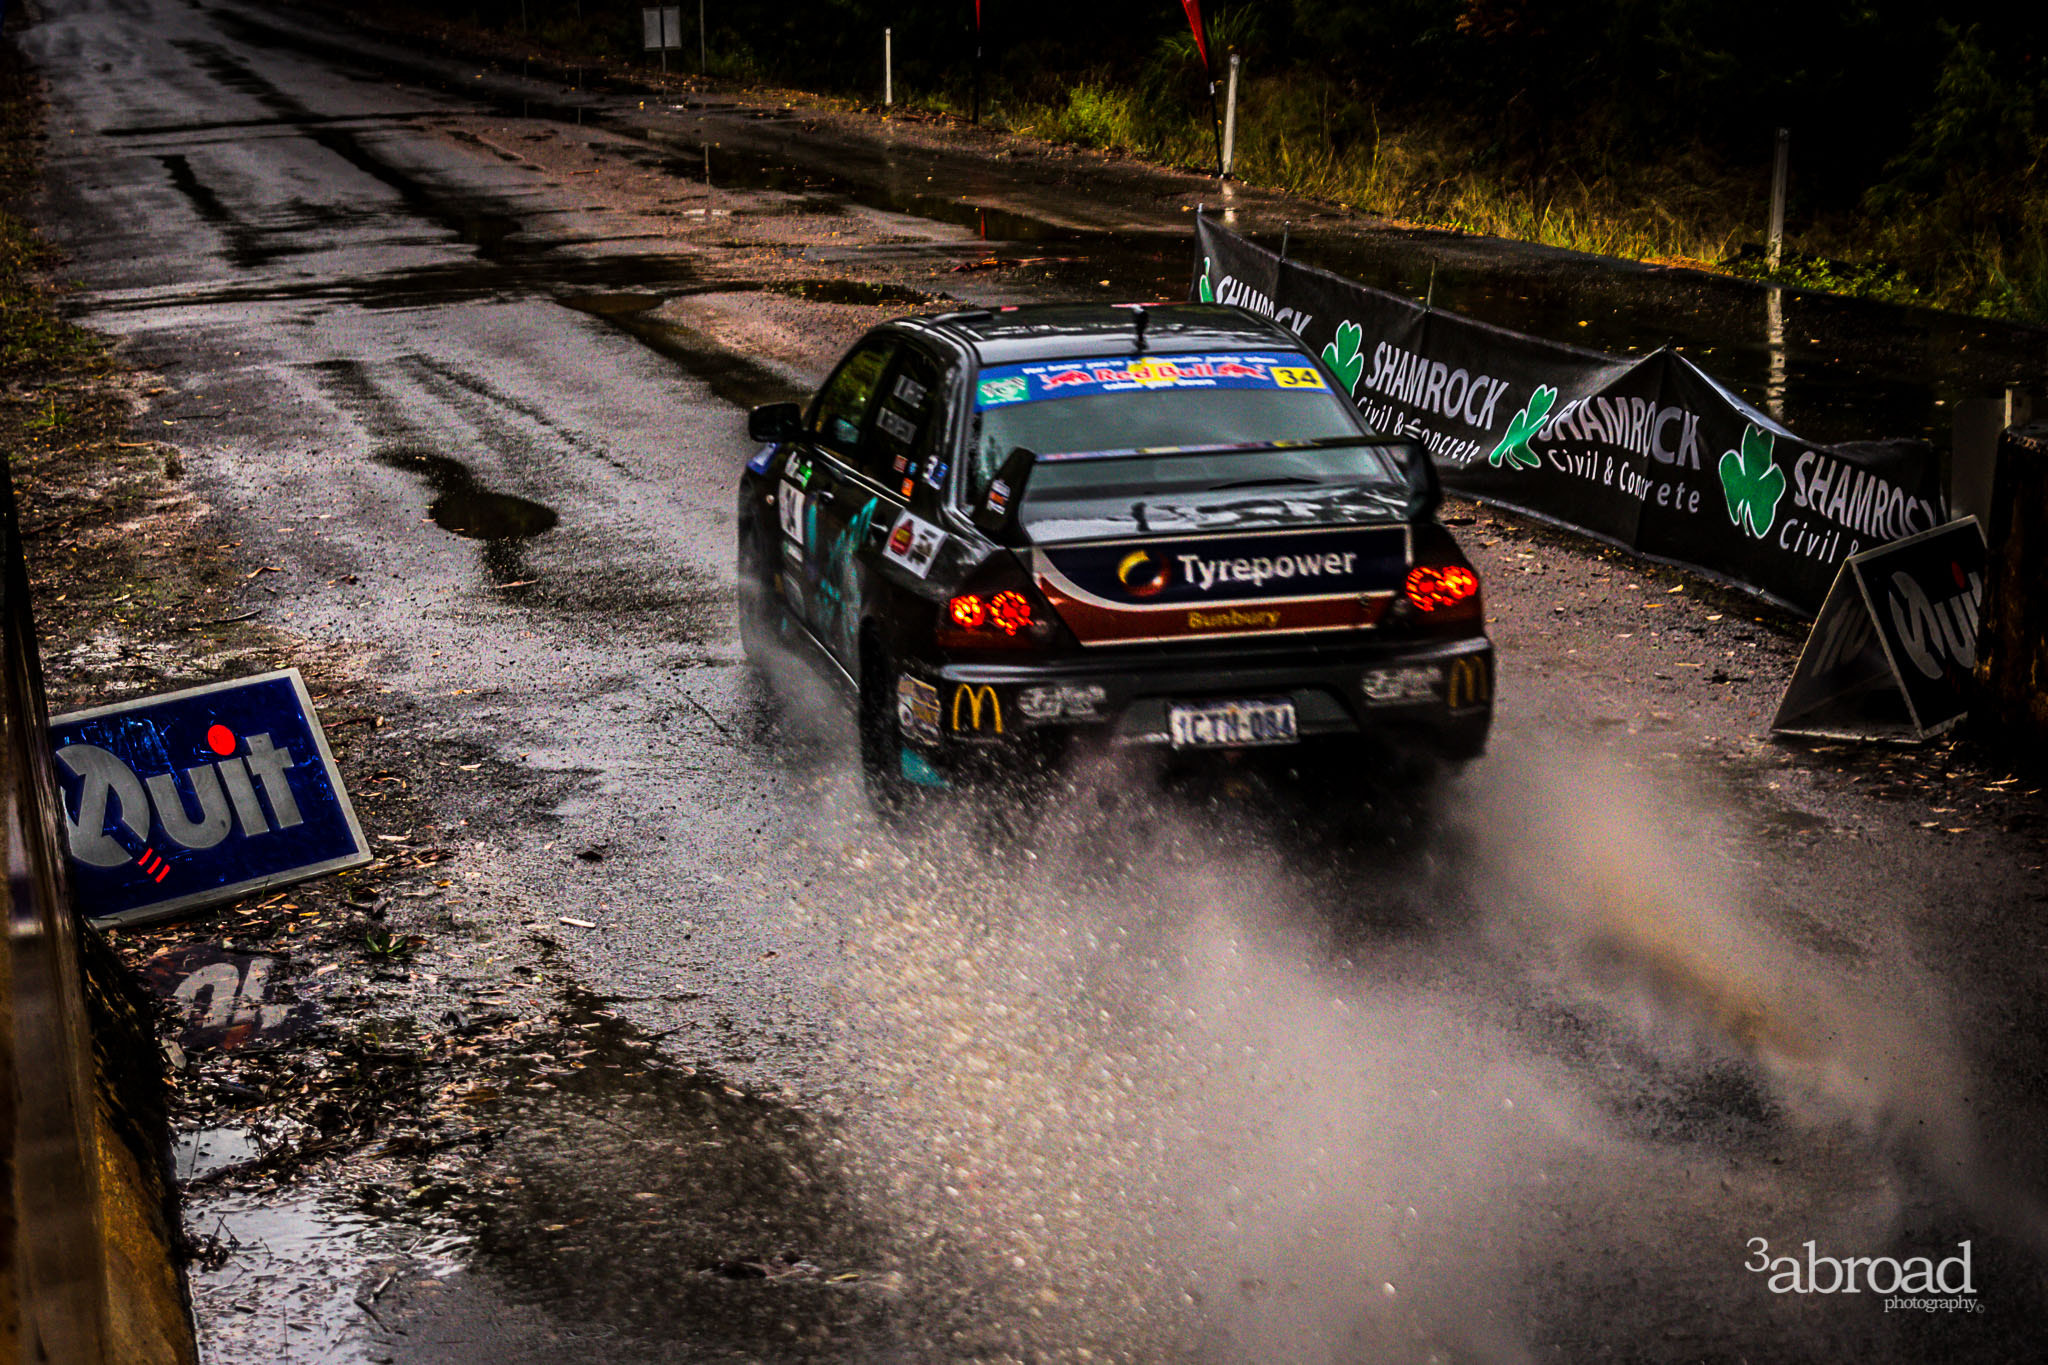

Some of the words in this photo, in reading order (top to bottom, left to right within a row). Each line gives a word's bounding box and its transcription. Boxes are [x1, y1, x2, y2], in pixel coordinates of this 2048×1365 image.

[1093, 367, 1151, 382] Red
[1156, 363, 1216, 378] Bull
[1279, 369, 1318, 386] 34
[1365, 341, 1509, 431] SHAMROCK
[1538, 396, 1701, 470] SHAMROCK
[1548, 449, 1599, 481] Civil
[1603, 455, 1614, 486] &
[1620, 461, 1701, 513] Concrete
[1779, 518, 1841, 564] Civil
[1177, 552, 1357, 591] Tyrepower
[55, 724, 304, 867] Quit
